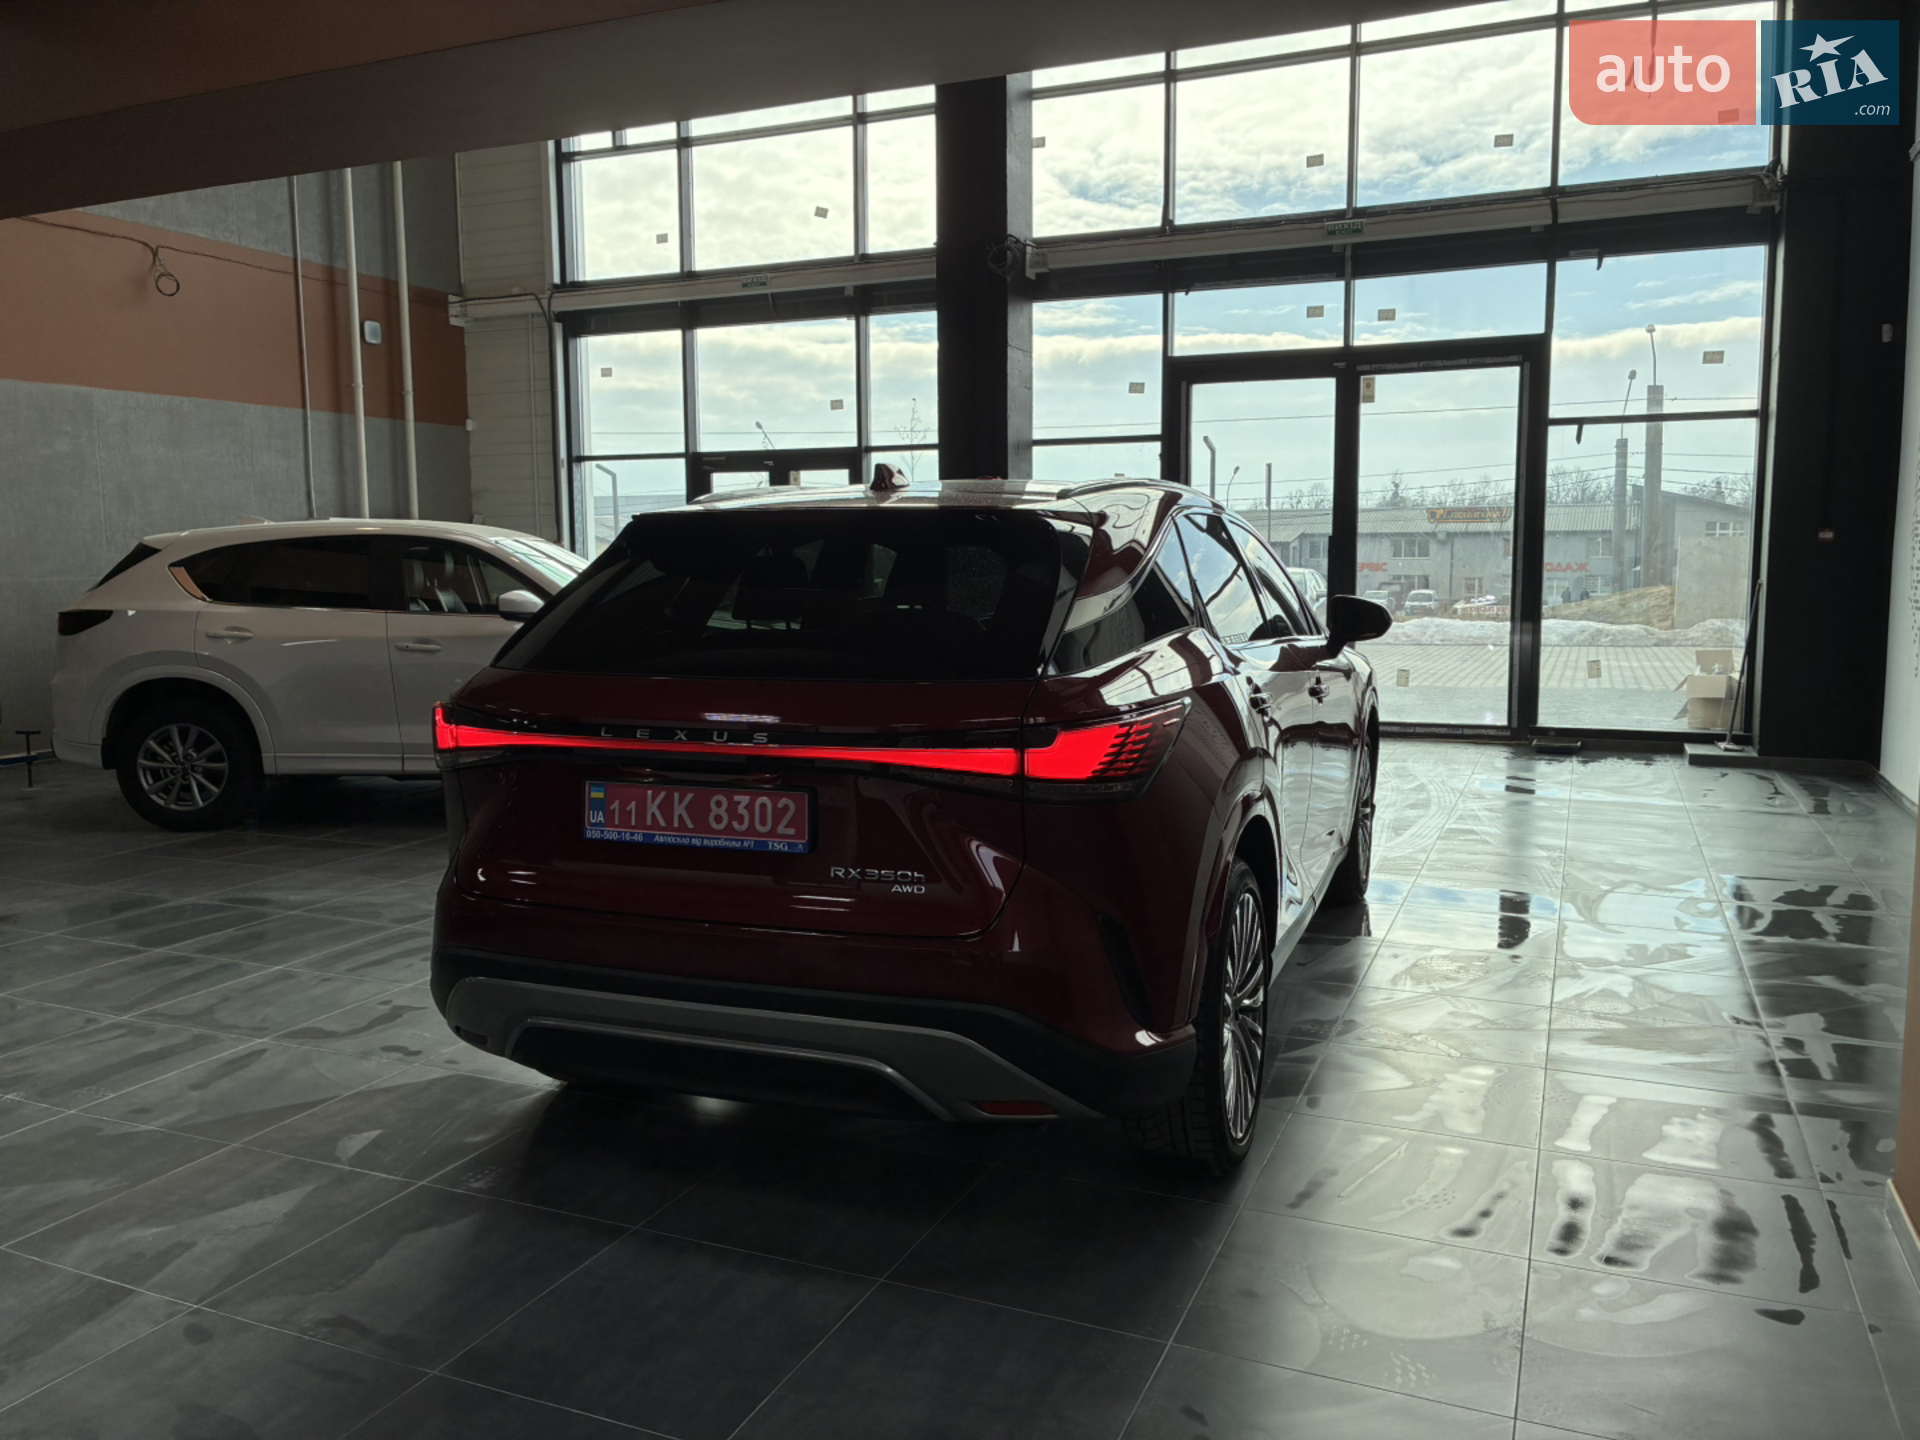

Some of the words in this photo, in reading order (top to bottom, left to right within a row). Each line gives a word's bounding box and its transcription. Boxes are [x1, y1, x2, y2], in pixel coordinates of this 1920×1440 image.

[600, 726, 769, 744] LEXUS
[589, 810, 605, 824] UA
[708, 794, 797, 836] 8302
[767, 841, 789, 851] TSG
[890, 884, 926, 894] AWD
